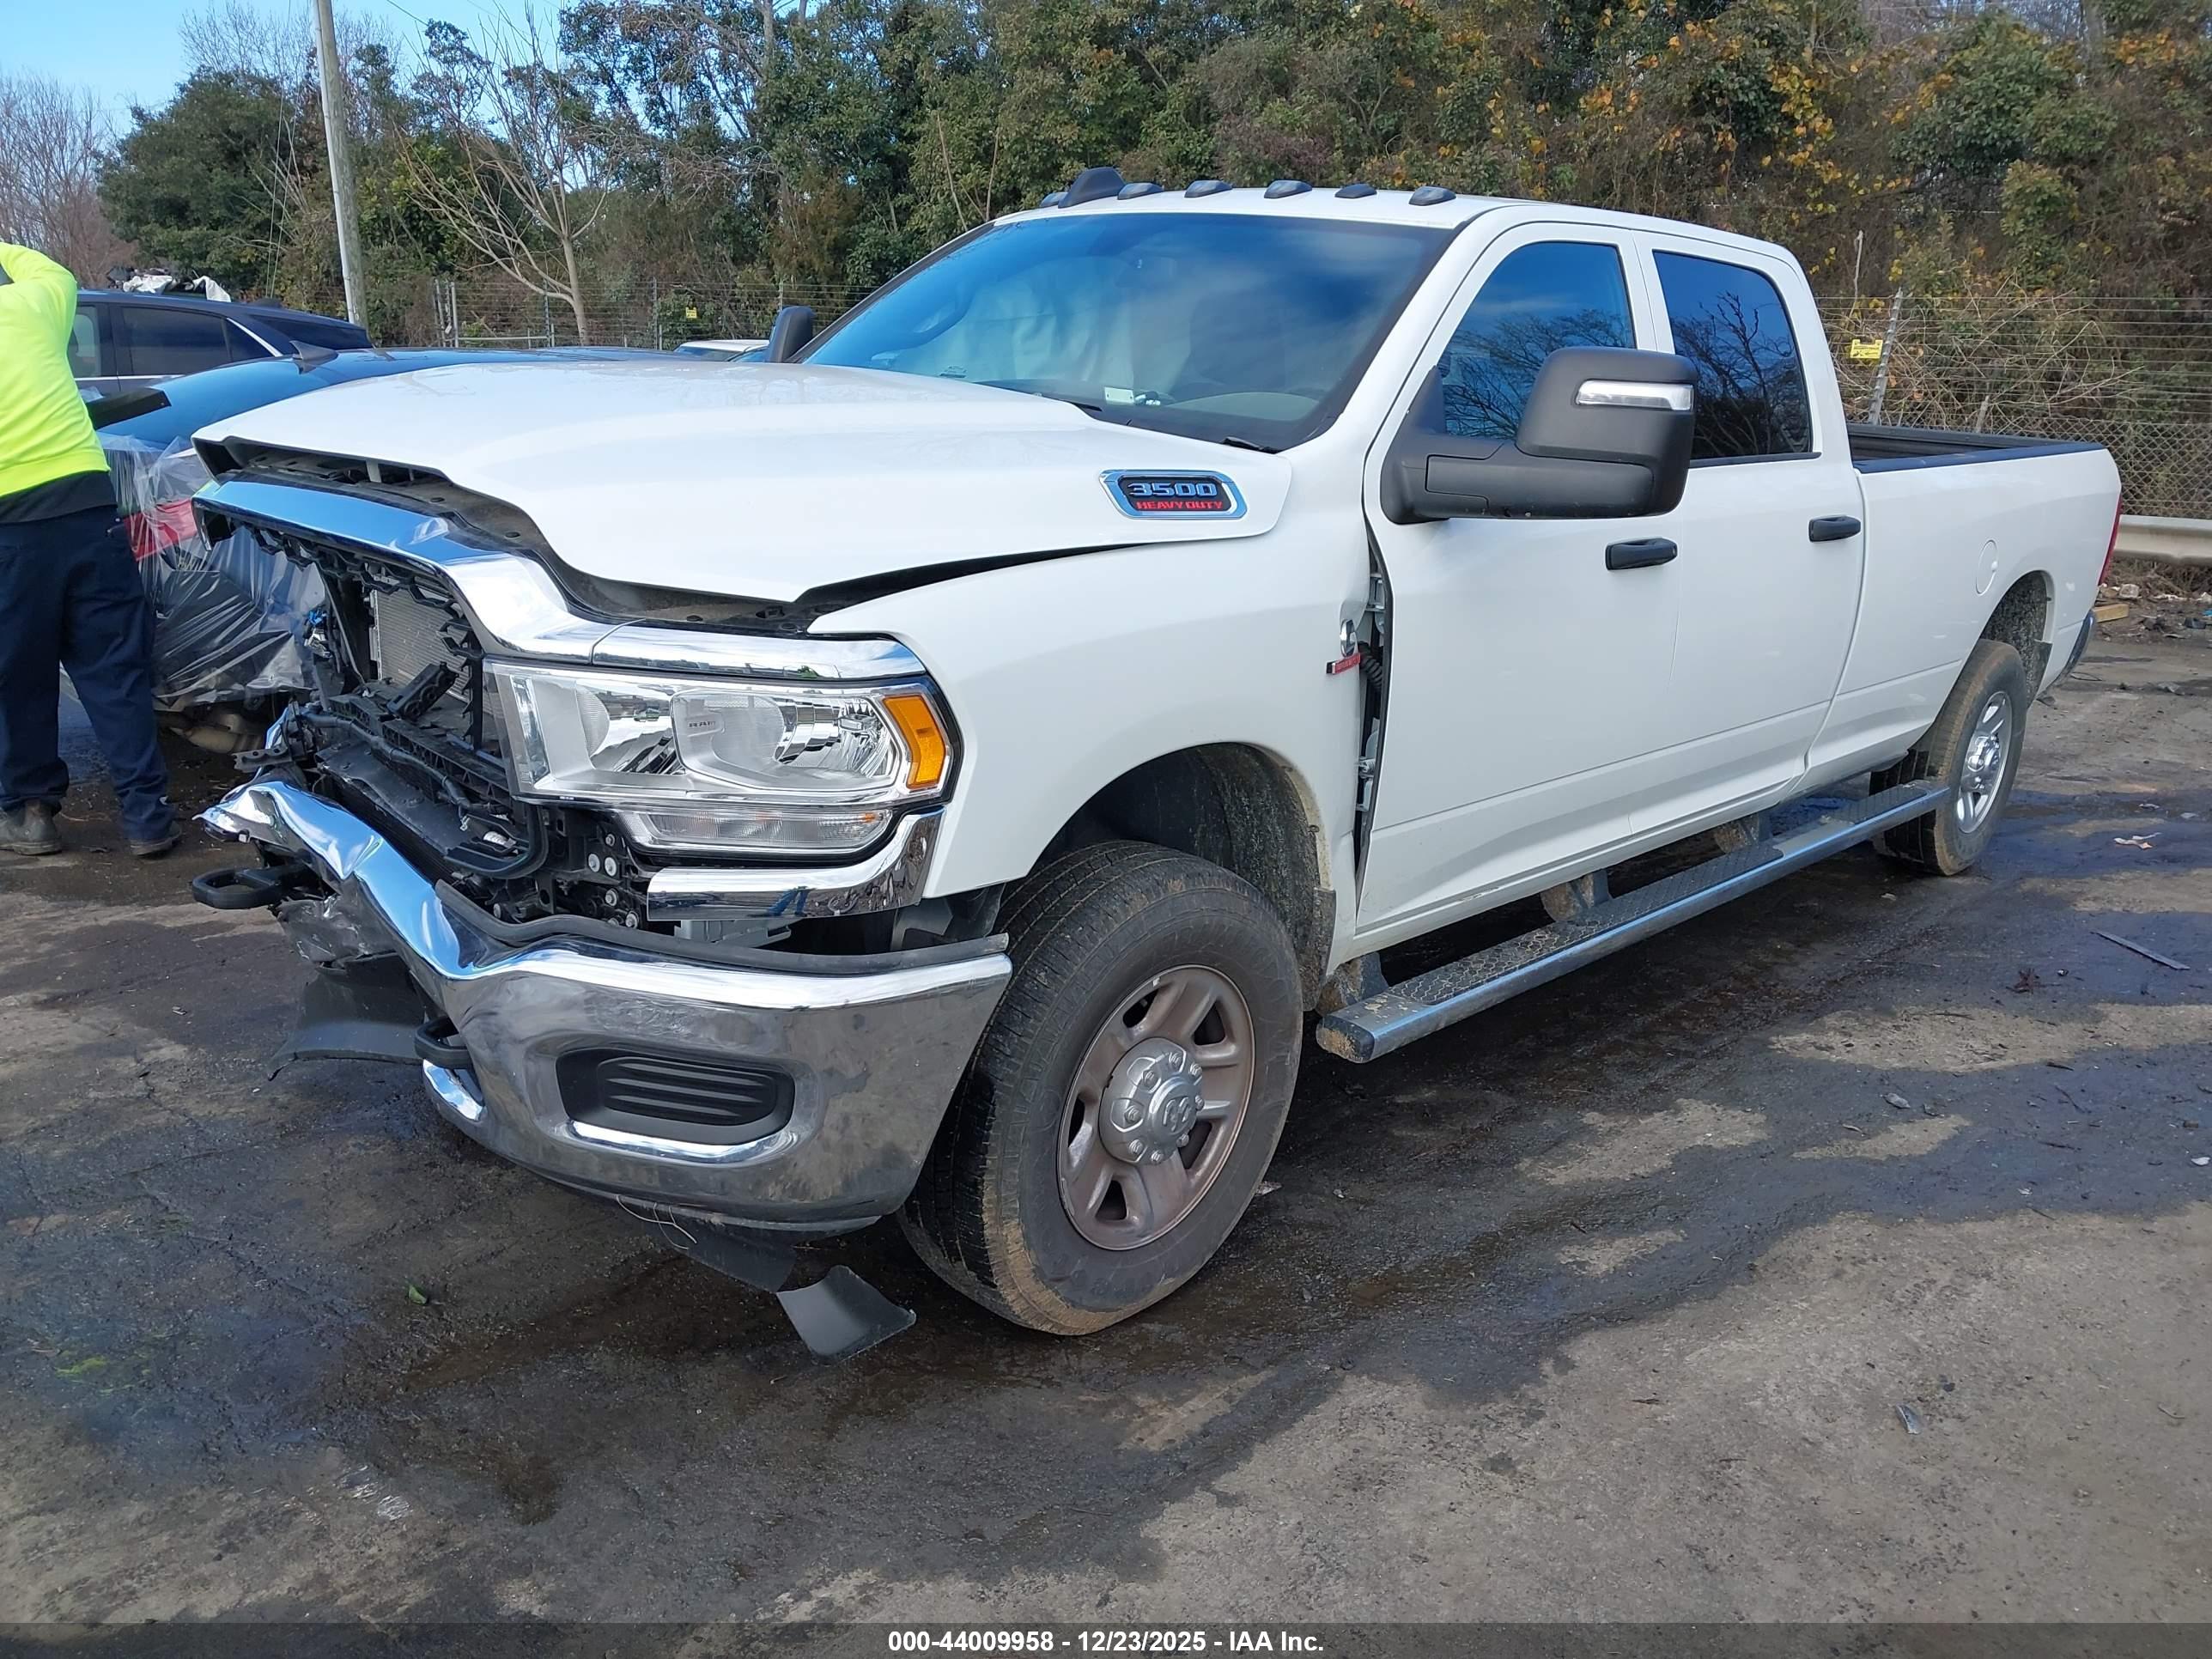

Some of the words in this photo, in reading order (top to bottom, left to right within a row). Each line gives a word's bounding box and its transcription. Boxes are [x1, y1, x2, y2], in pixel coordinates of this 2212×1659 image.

[1127, 482, 1218, 497] 3500
[1135, 501, 1185, 510] HEAVY
[1186, 501, 1223, 510] DUTY
